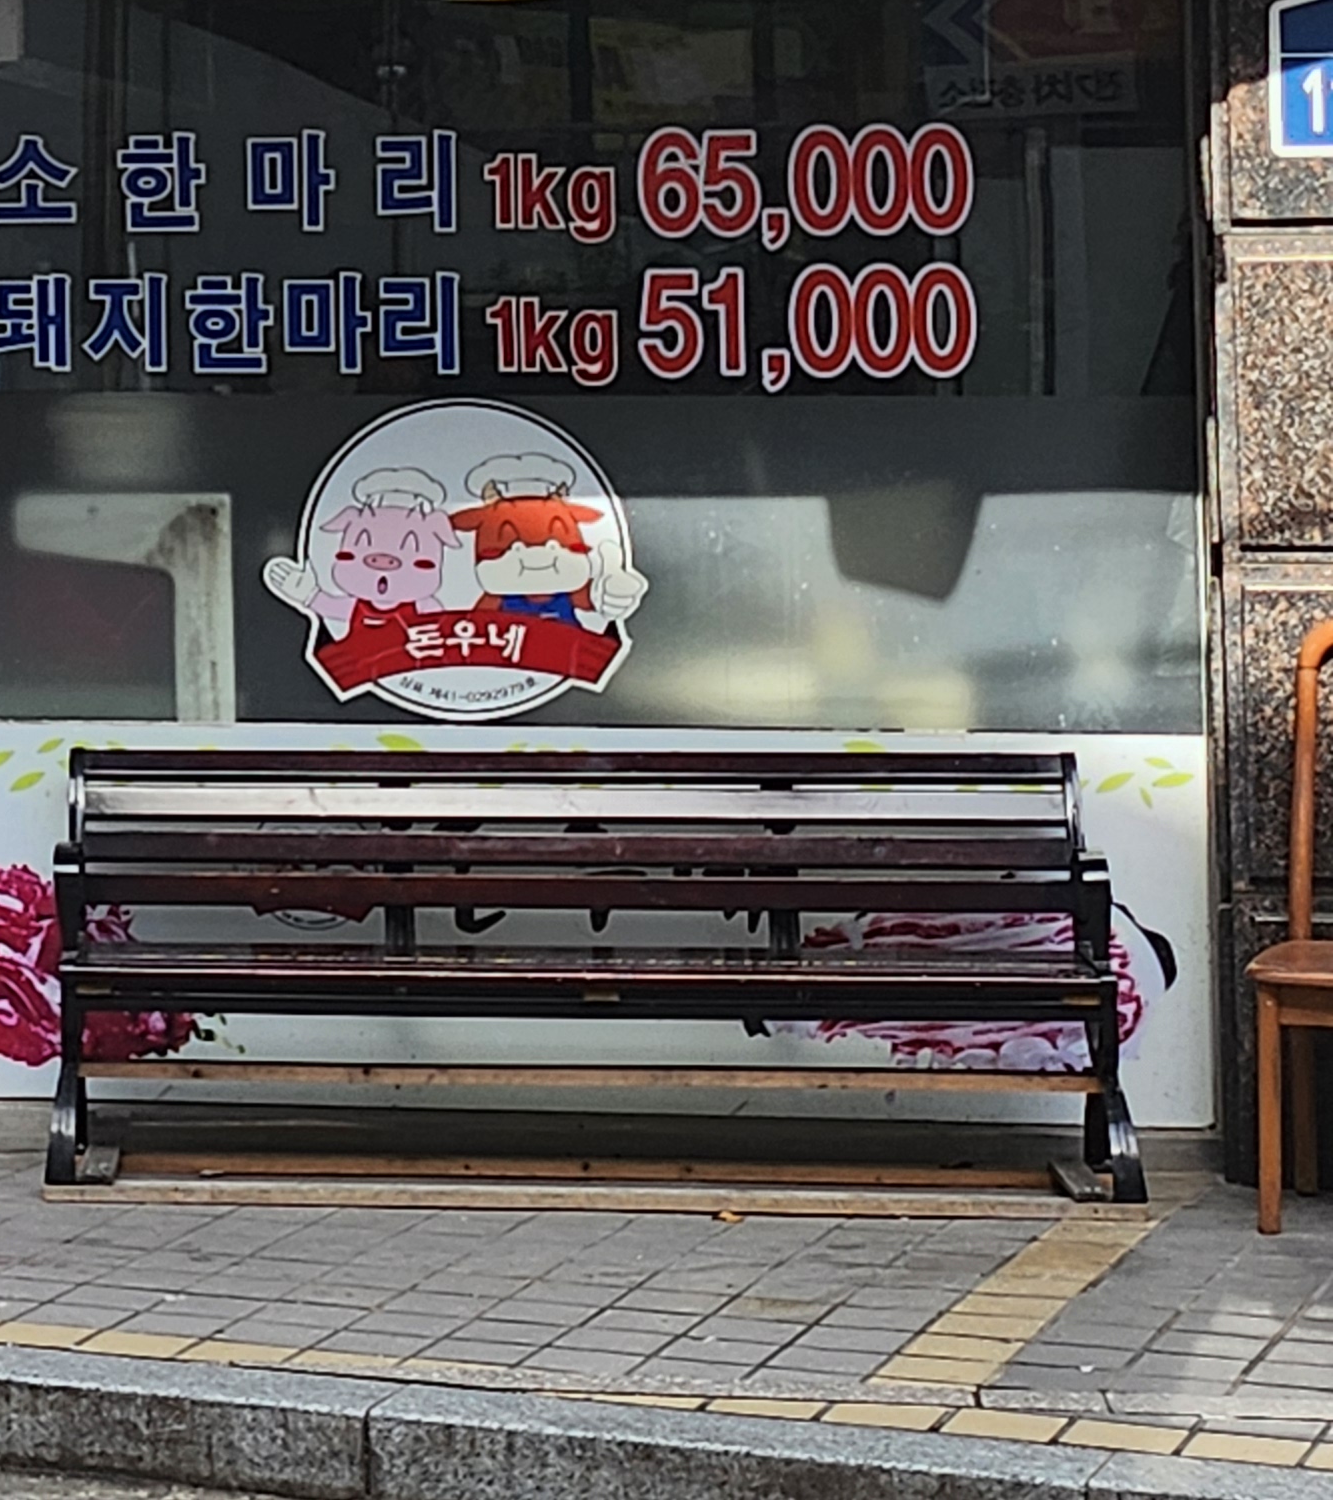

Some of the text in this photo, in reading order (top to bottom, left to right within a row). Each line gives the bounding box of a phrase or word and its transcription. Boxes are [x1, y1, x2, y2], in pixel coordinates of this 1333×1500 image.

[484, 153, 616, 243] 1kg
[637, 123, 975, 250] 65,000
[486, 296, 618, 386] 1kg
[638, 262, 977, 393] 51,000
[405, 622, 527, 663] 돈우네
